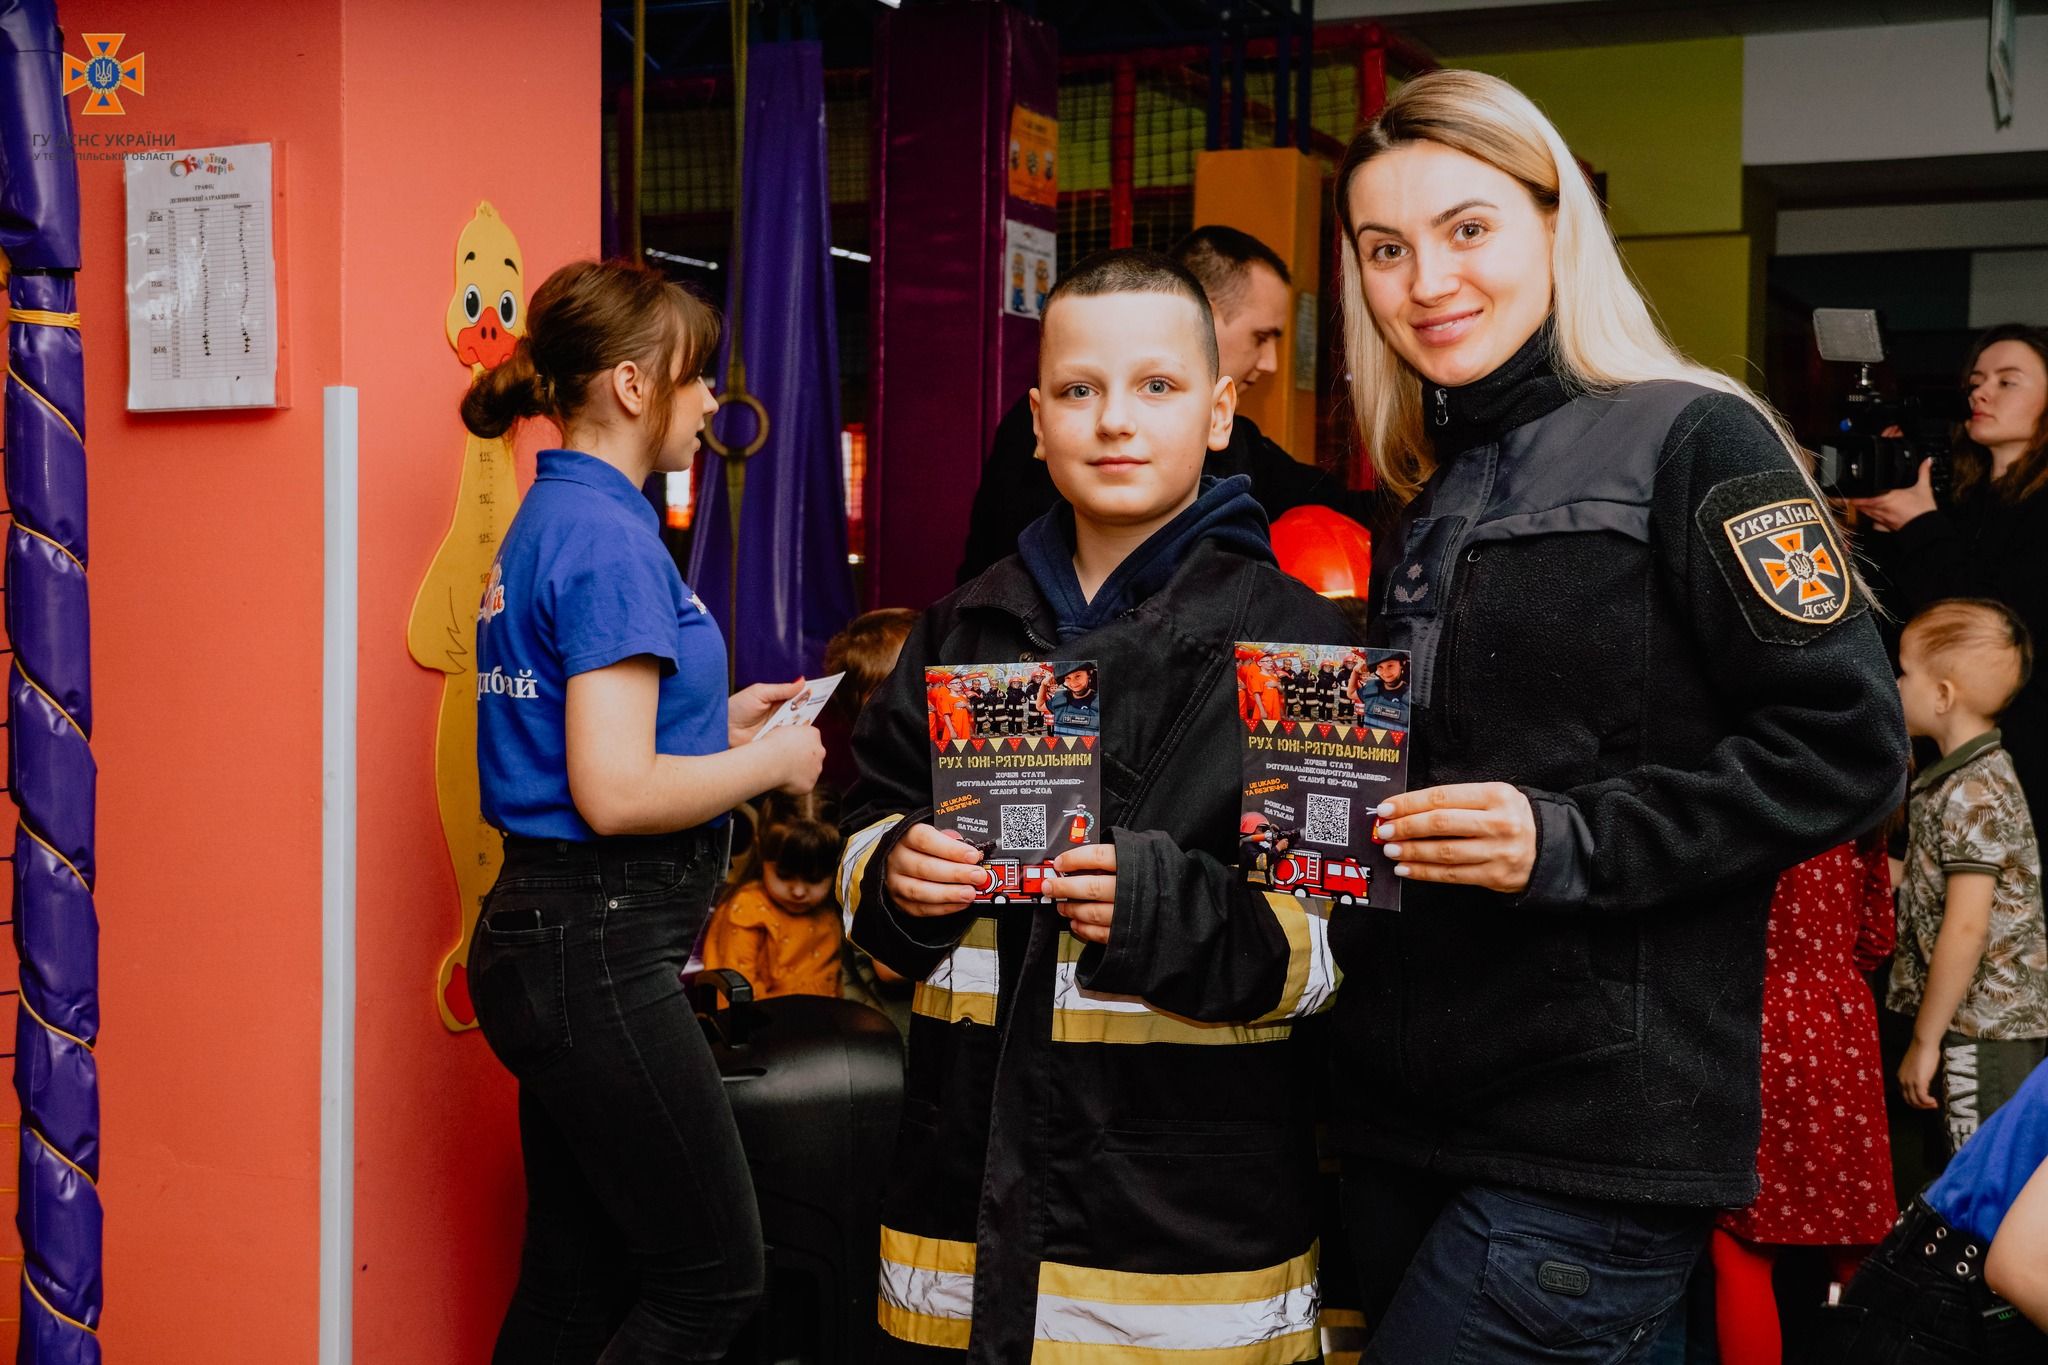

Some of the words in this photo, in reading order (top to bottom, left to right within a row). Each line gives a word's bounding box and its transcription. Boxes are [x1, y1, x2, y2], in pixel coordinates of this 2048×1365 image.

[1733, 505, 1818, 540] УКРАЇНА
[1802, 598, 1840, 618] ДСНС
[1248, 736, 1273, 750] РУХ
[1277, 738, 1400, 763] ЮНІ-РЯТУВАЛЬНИКИ
[938, 756, 963, 769] РУХ
[967, 753, 1093, 768] ЮНІ-РЯТУВАЛЬНИКИ
[1329, 761, 1353, 770] СТАТИ
[1297, 775, 1325, 784] СКАНУЙ
[989, 787, 1018, 795] СКАНУЙ
